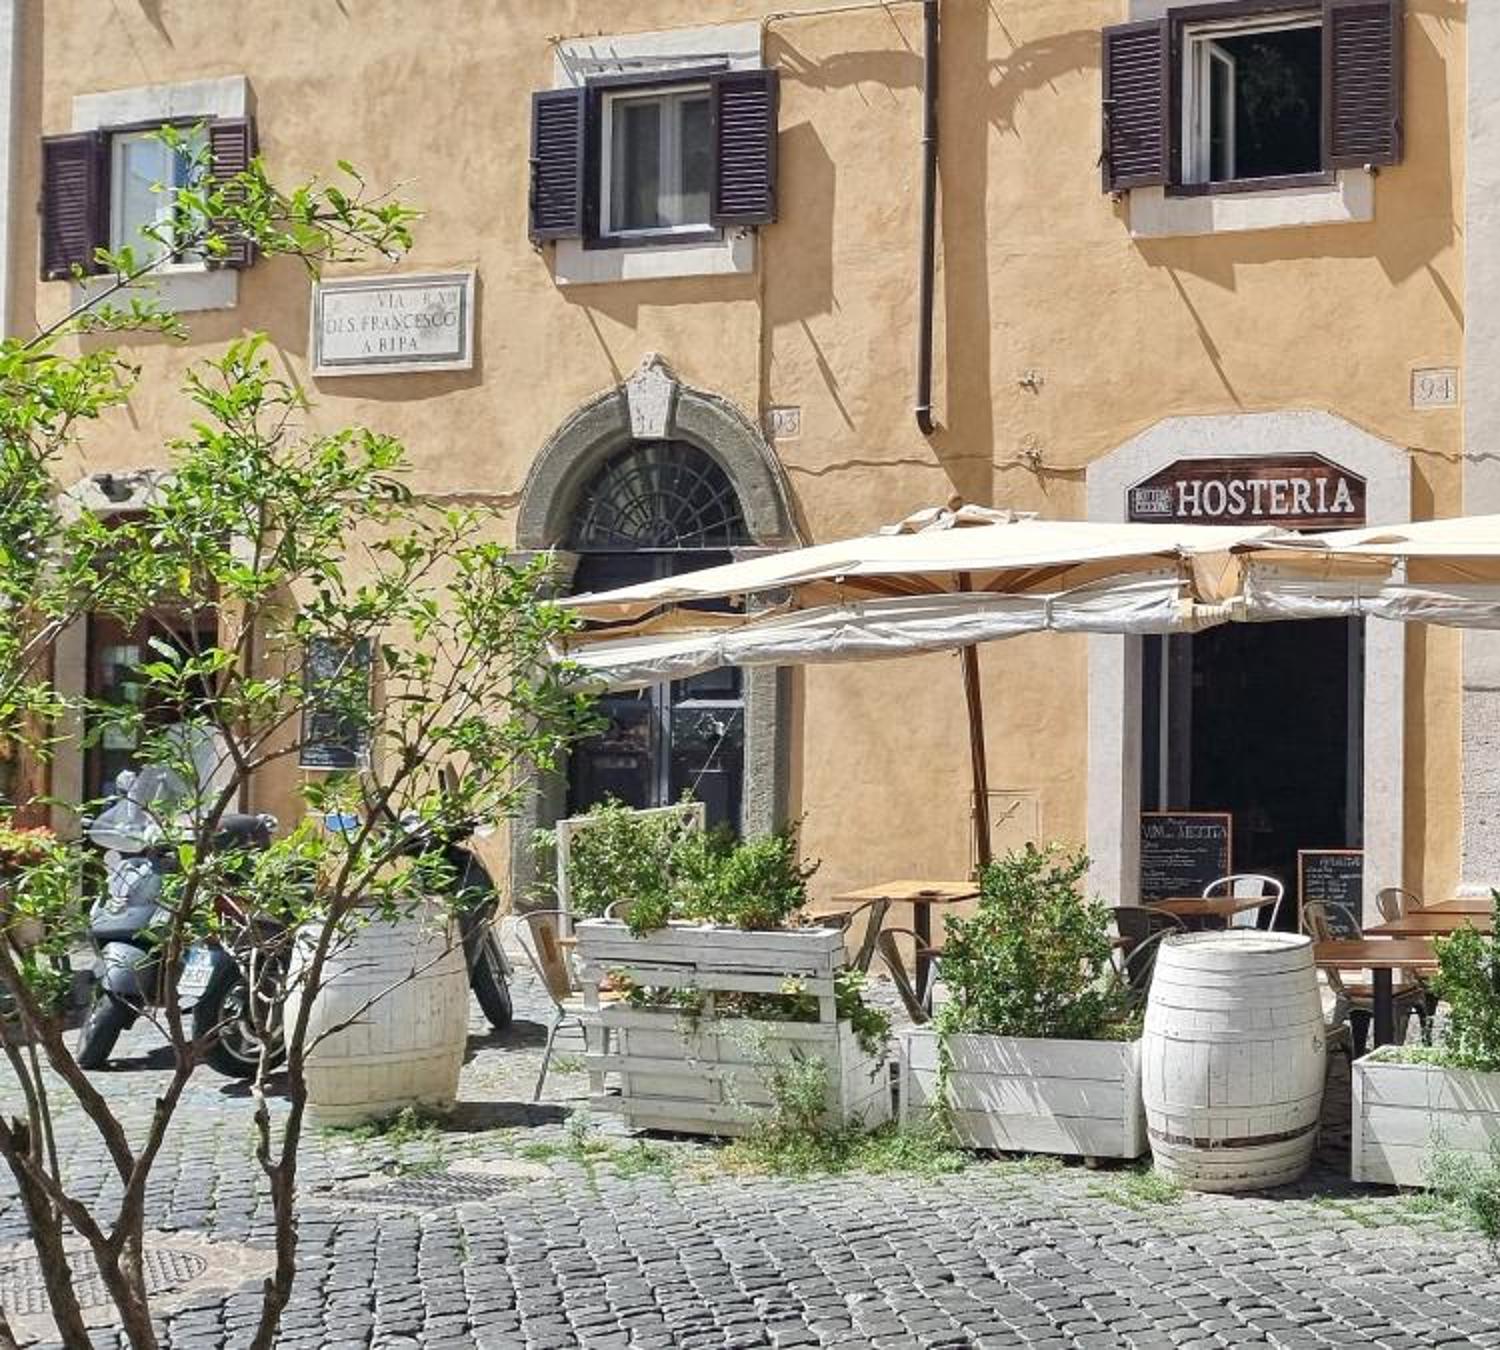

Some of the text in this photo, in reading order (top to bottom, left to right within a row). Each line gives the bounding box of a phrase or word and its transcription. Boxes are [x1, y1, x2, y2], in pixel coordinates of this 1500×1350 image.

[377, 292, 405, 308] VIA
[360, 312, 457, 332] FRANCESCO
[361, 336, 418, 353] A RIPA
[1418, 377, 1450, 400] 94
[1175, 477, 1355, 517] HOSTERIA
